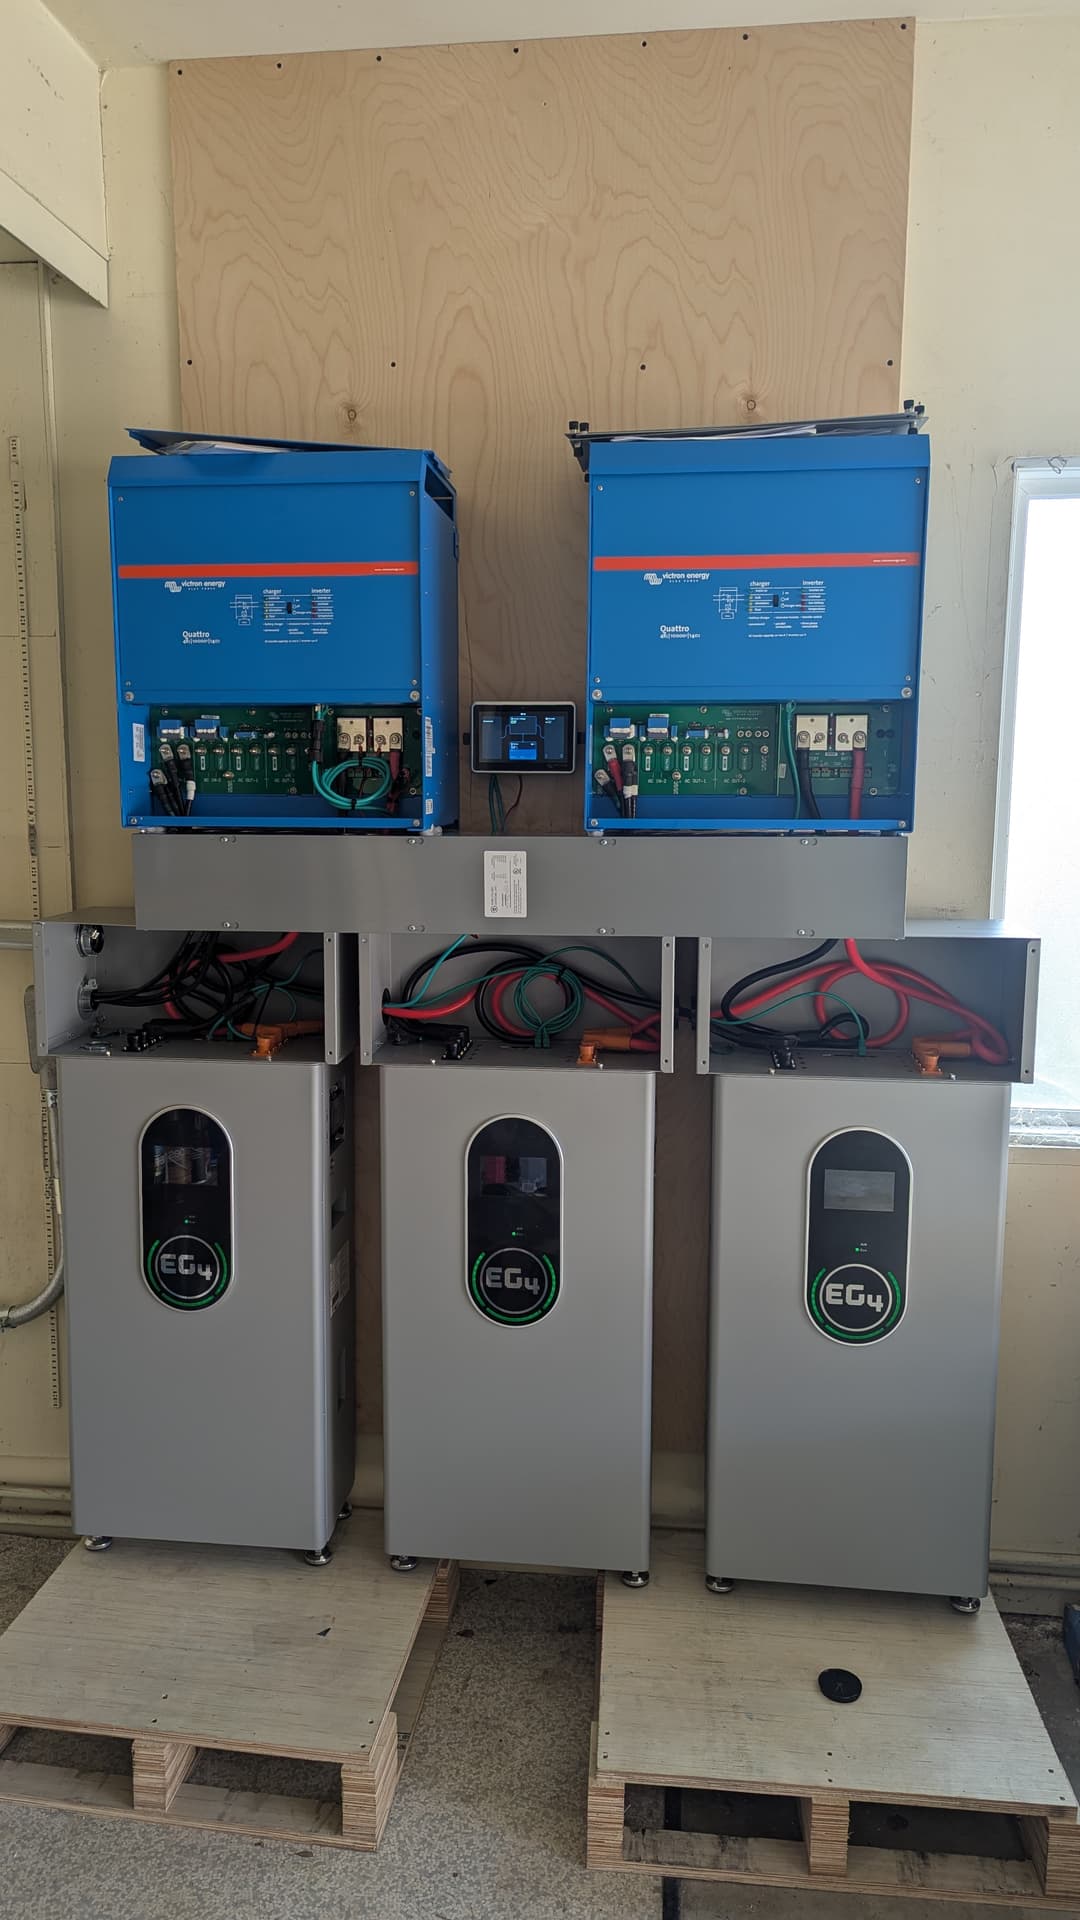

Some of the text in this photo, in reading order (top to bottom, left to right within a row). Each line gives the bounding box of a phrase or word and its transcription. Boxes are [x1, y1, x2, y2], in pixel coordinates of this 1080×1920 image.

[183, 630, 210, 639] Quattro
[660, 625, 690, 634] Quattro
[160, 1253, 213, 1281] EG4
[485, 1266, 540, 1296] EG4
[825, 1282, 884, 1313] EG4
